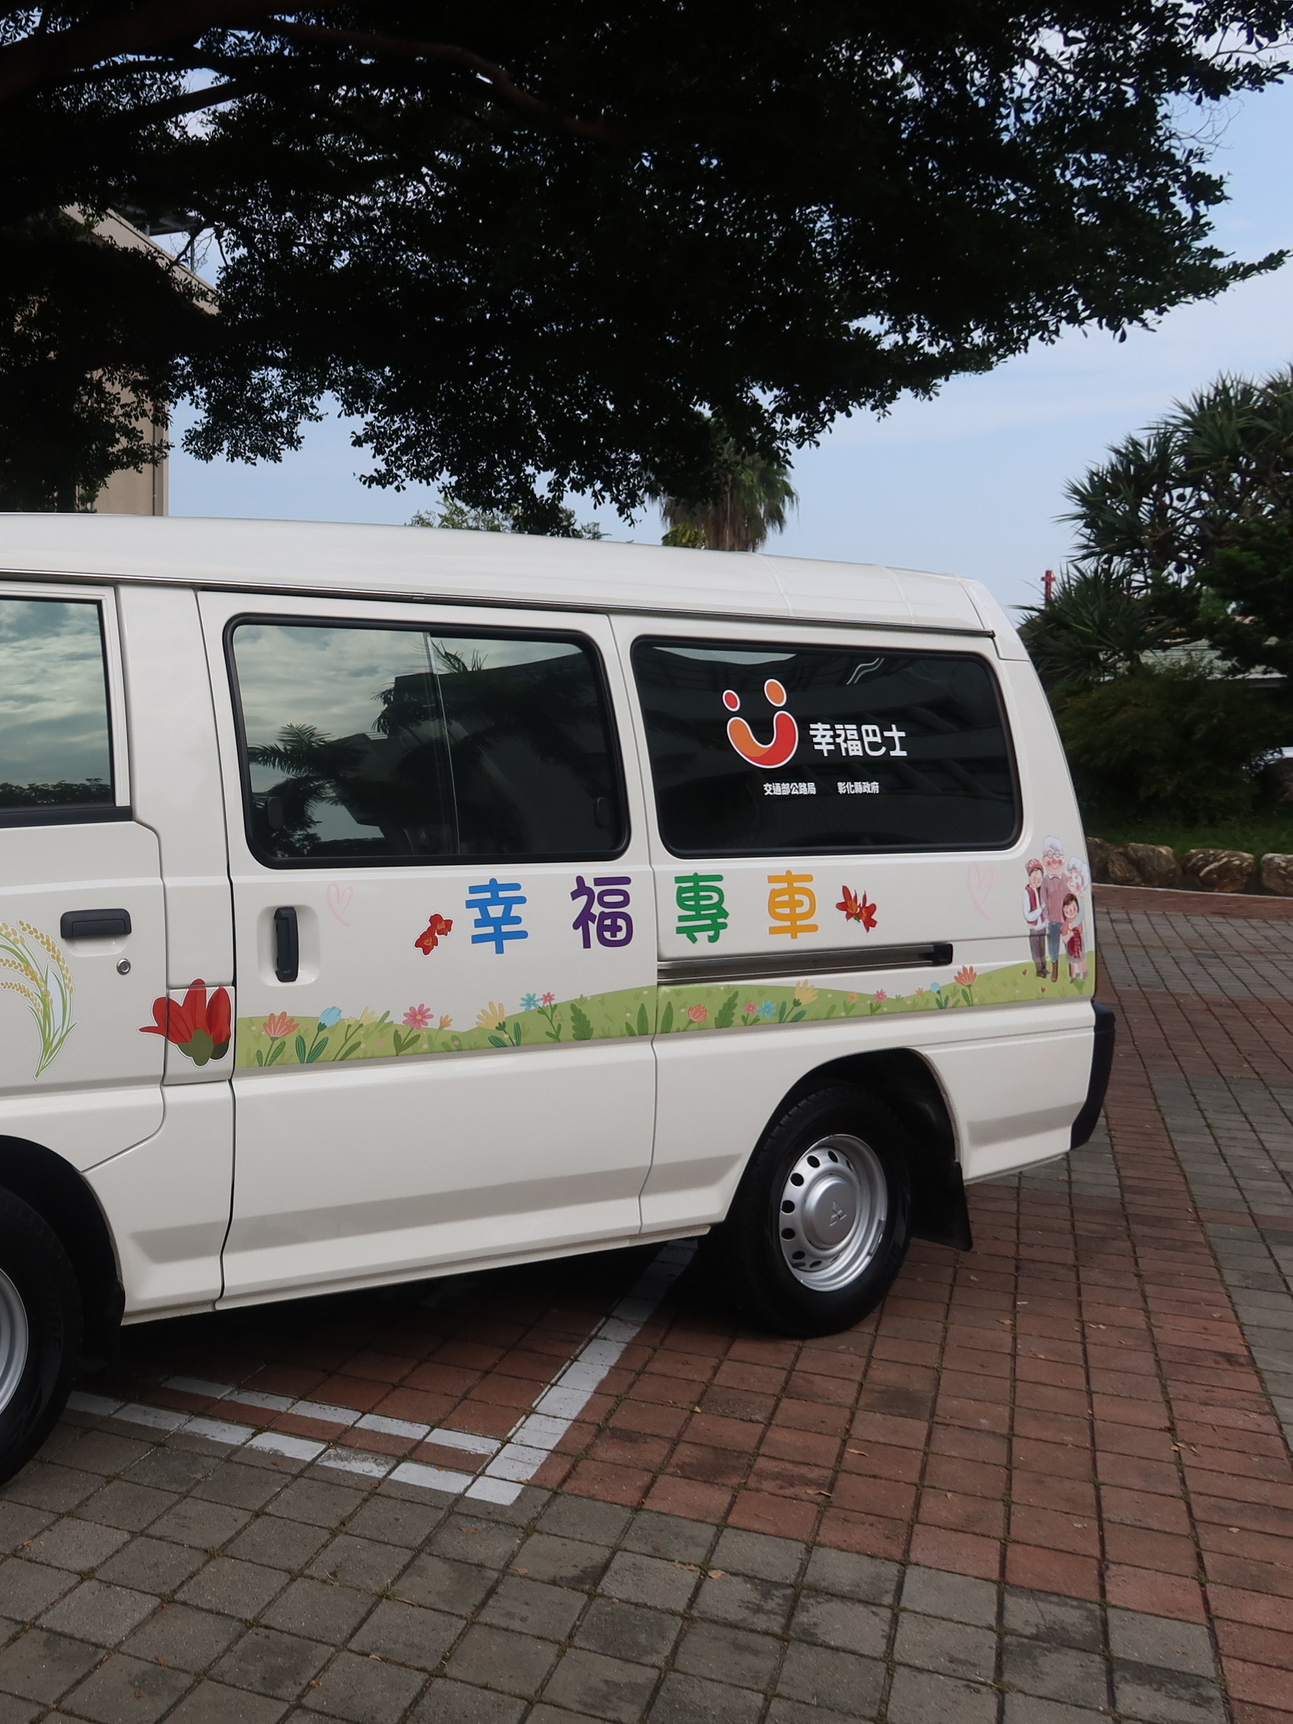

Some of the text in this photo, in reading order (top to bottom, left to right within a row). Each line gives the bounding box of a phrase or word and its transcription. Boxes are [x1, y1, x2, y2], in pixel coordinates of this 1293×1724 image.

[809, 722, 908, 757] 幸福巴士
[763, 782, 816, 795] 交通部公路局
[465, 870, 819, 954] 幸福專車
